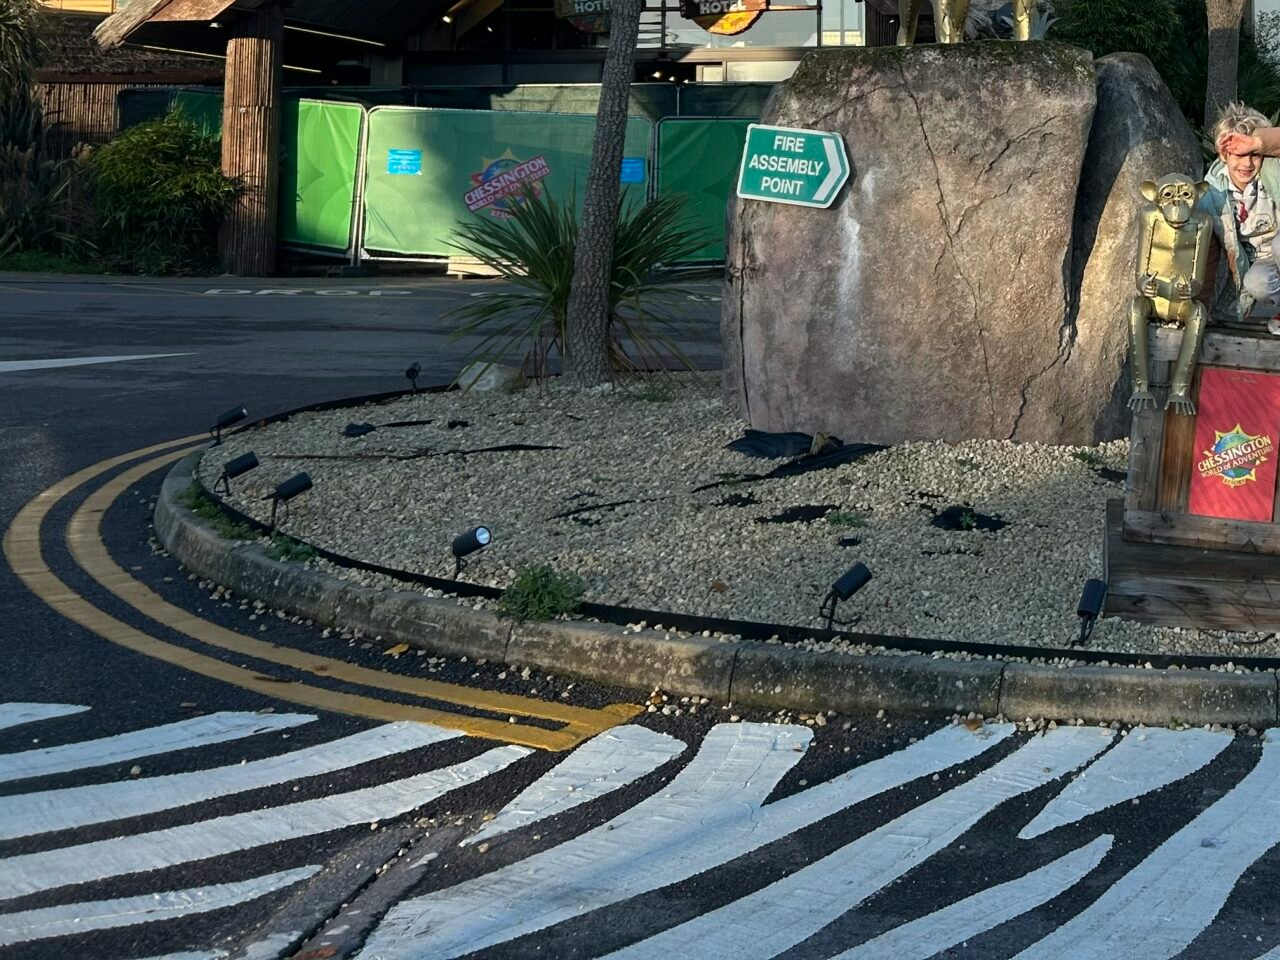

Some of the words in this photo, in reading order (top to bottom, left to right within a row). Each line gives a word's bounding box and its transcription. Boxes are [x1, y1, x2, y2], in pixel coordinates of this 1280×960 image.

[773, 135, 806, 153] FIRE
[748, 154, 824, 177] ASSEMBLY
[464, 156, 547, 205] CHESSINGTON
[760, 176, 804, 196] POINT
[468, 195, 495, 211] WORLD
[1197, 435, 1272, 472] CHESSINGTON
